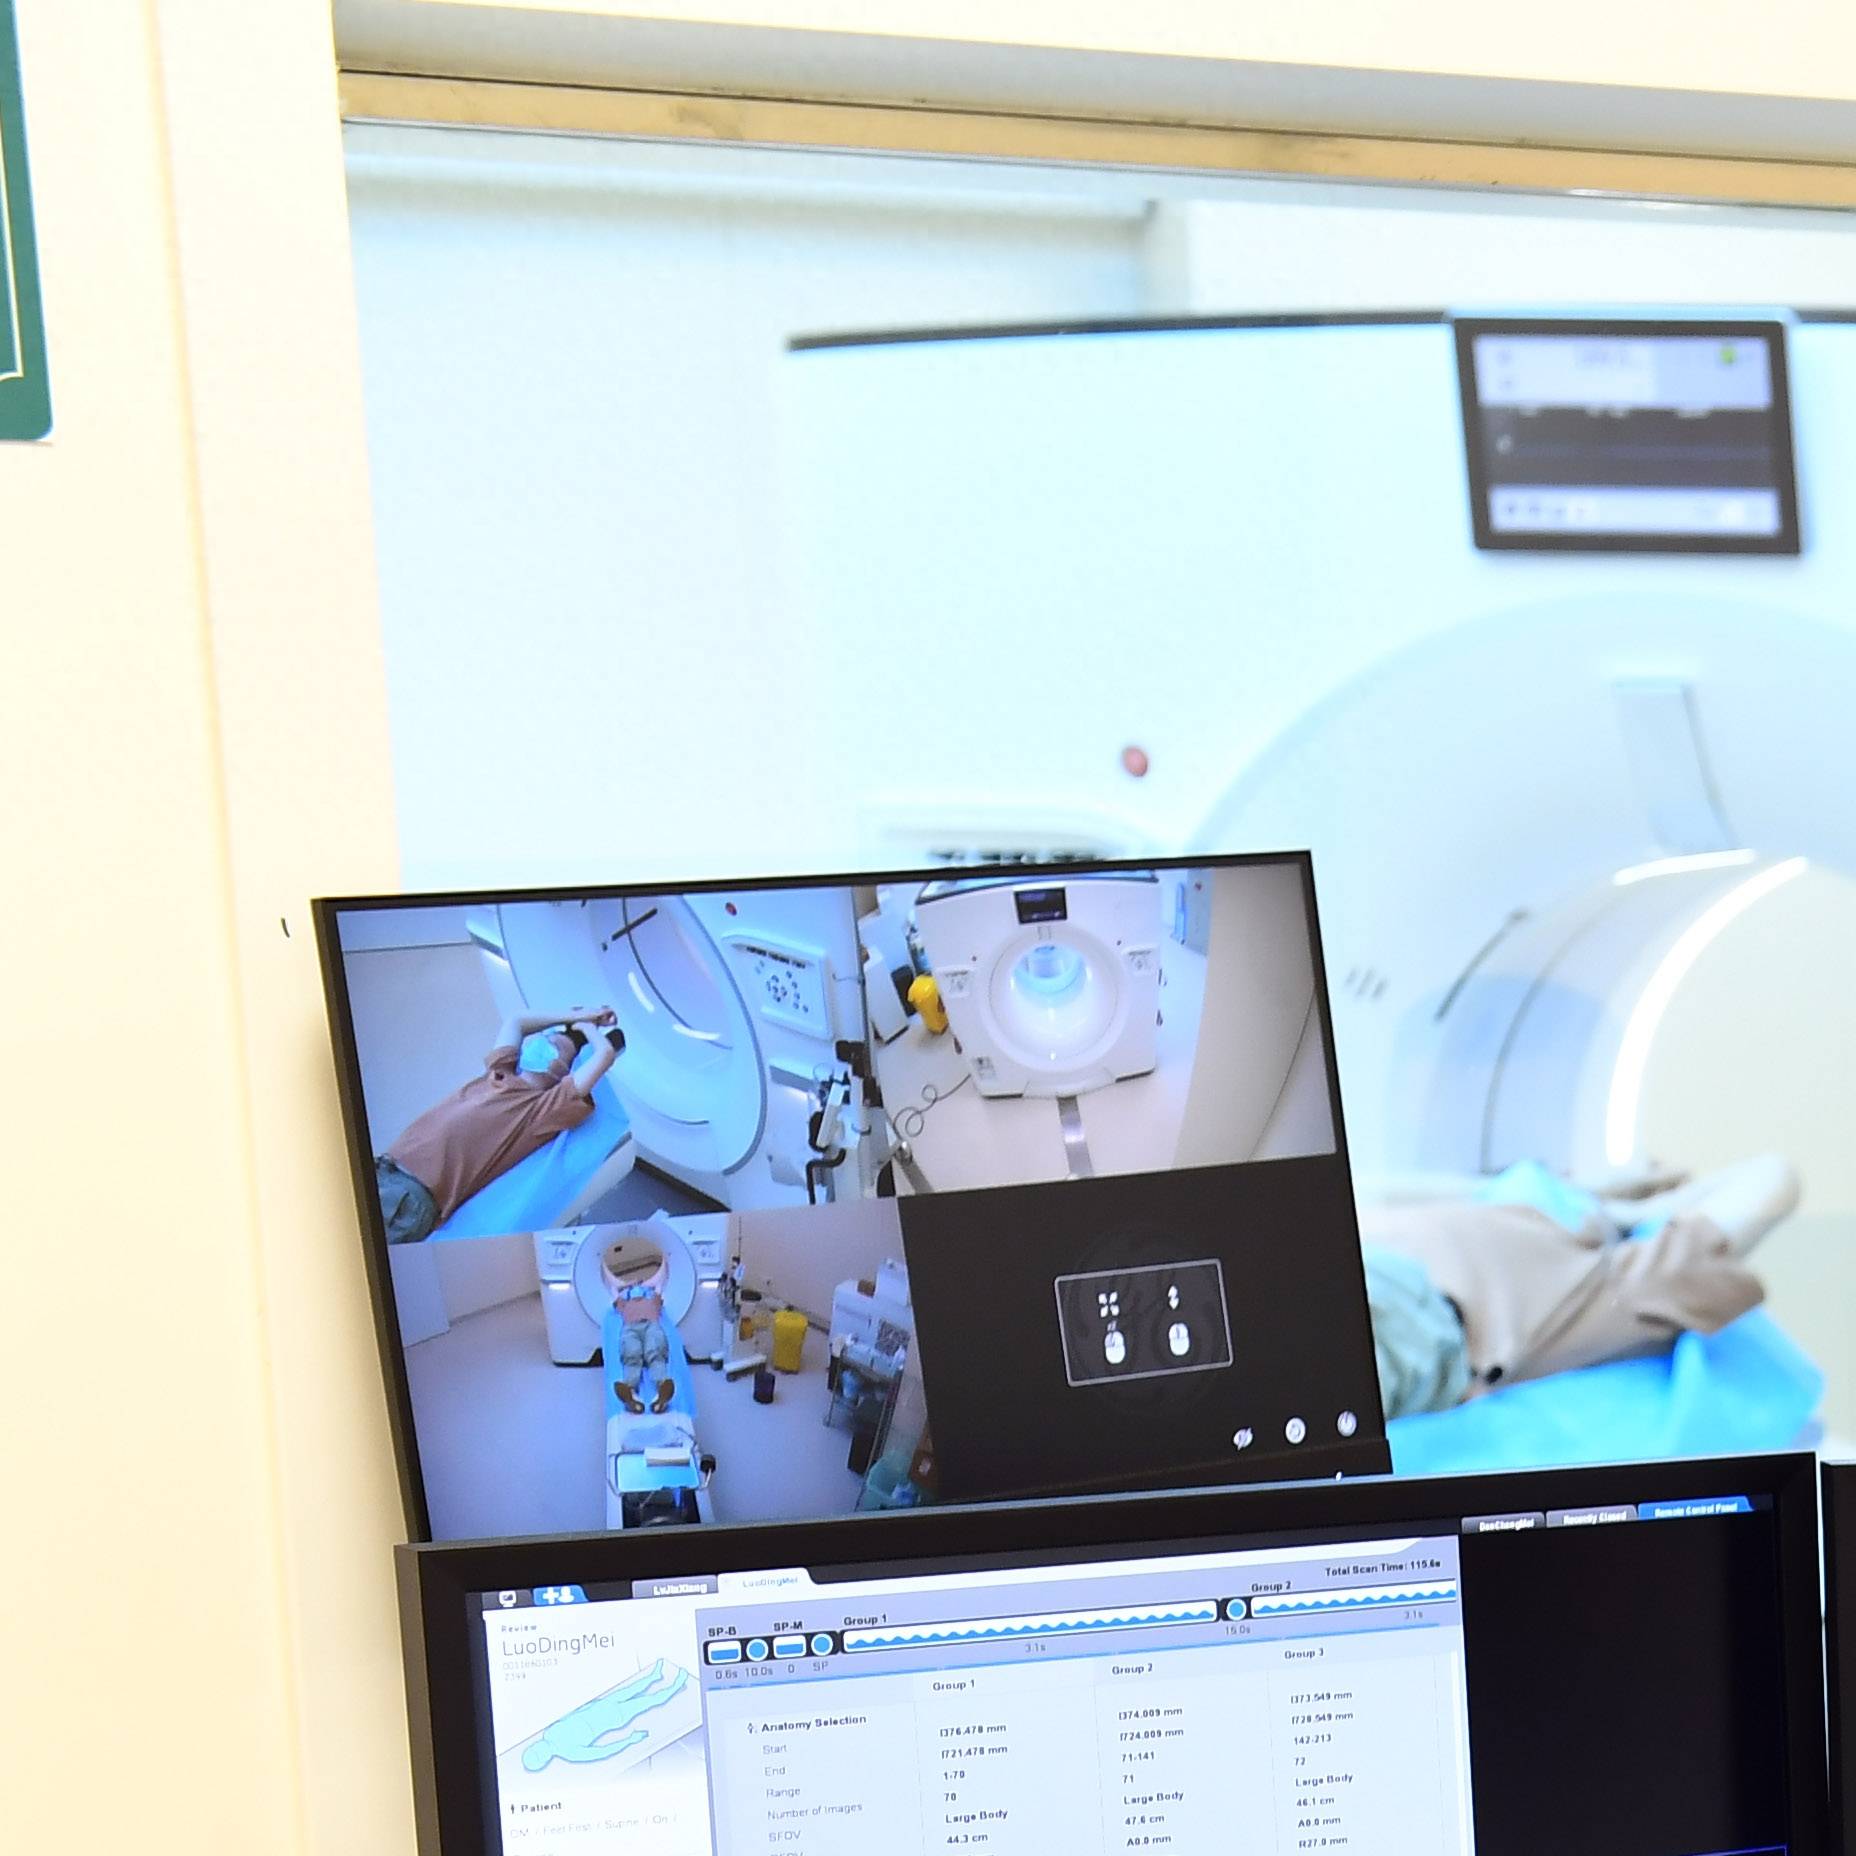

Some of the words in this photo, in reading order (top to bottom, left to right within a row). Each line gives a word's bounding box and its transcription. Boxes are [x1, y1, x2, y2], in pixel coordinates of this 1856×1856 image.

[1325, 1567, 1350, 1577] Total
[1352, 1564, 1378, 1575] Scan
[1251, 1582, 1283, 1593] Group
[773, 1621, 803, 1632] SP-M
[843, 1616, 878, 1627] Group
[882, 1614, 887, 1623] 1
[501, 1624, 538, 1633] Review
[708, 1626, 737, 1637] SP-B
[502, 1634, 615, 1657] LuoDingMei
[932, 1680, 967, 1692] Group
[971, 1679, 975, 1688] 1
[761, 1719, 812, 1733] Anatomy
[815, 1715, 867, 1727] Selection
[763, 1744, 787, 1755] Start
[764, 1766, 786, 1777] End
[766, 1787, 801, 1799] Range
[520, 1801, 562, 1813] Patient
[767, 1807, 809, 1821] Number
[812, 1806, 822, 1816] of
[824, 1802, 863, 1816] Images
[945, 1811, 977, 1824] Large
[980, 1809, 1009, 1821] Body
[972, 1833, 988, 1842] cm
